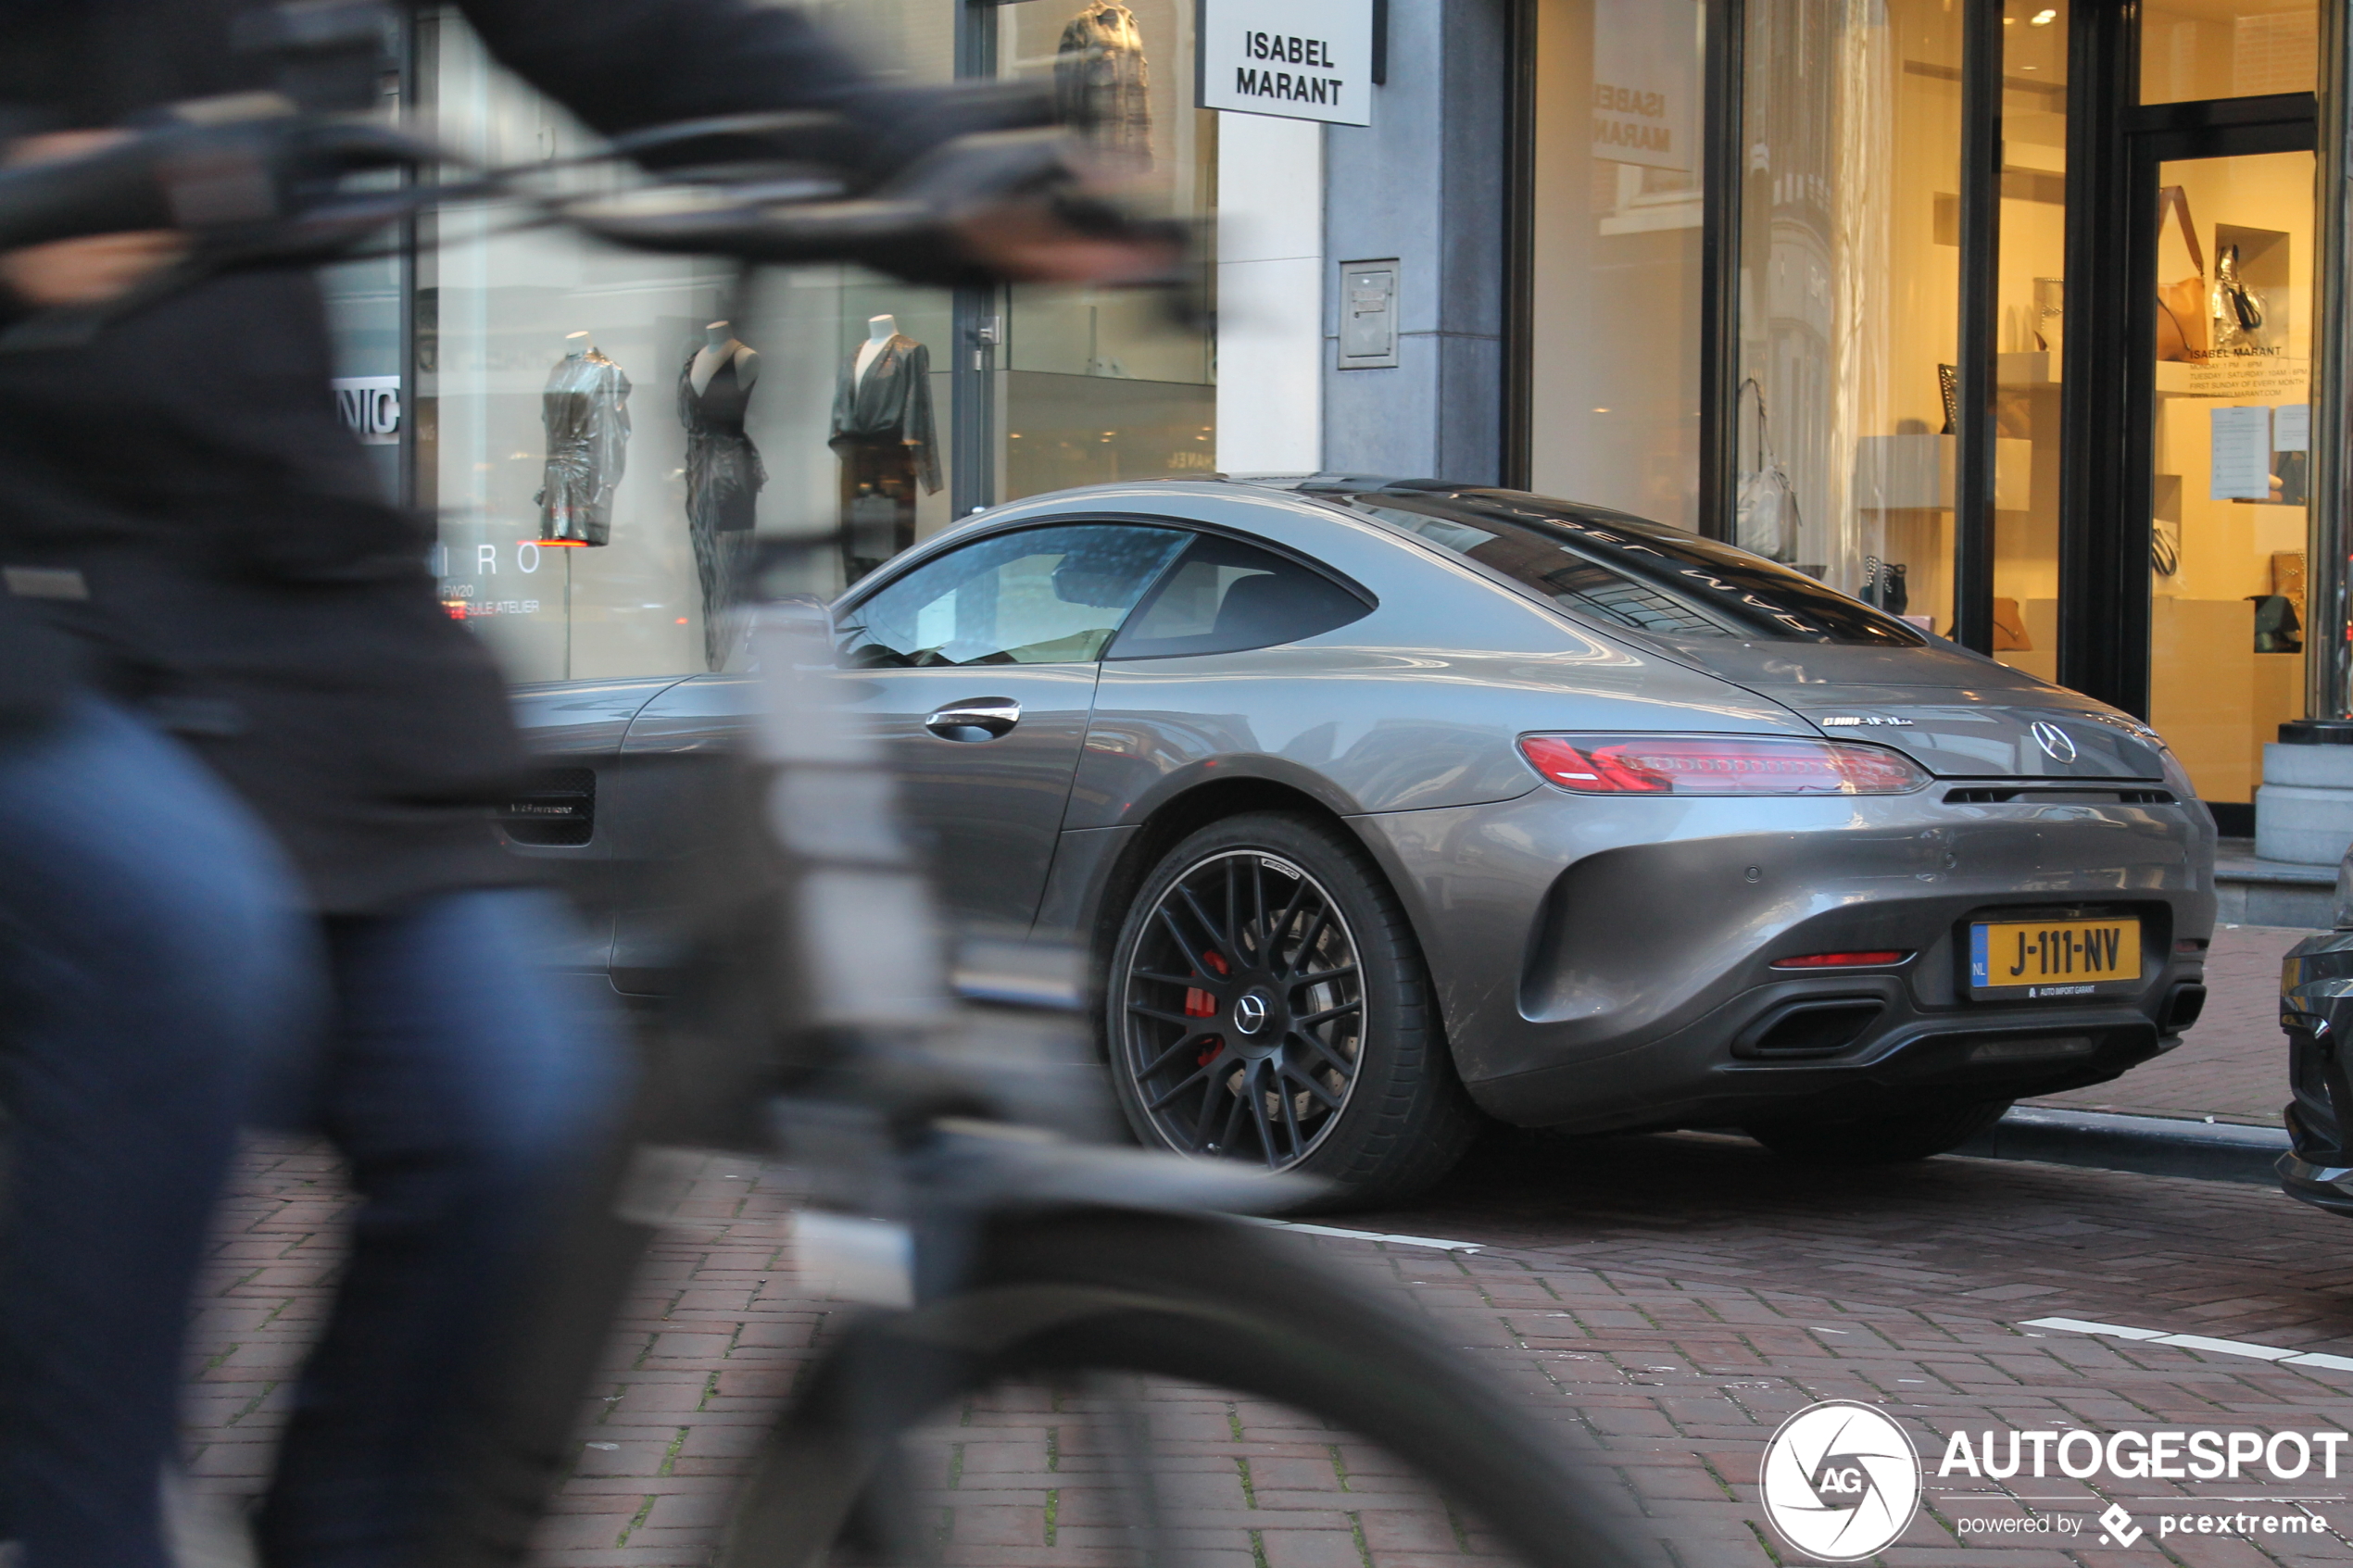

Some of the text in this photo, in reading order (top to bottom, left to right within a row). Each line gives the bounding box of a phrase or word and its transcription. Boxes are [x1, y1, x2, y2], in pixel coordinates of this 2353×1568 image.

[1246, 31, 1335, 68] ISABEL
[1237, 67, 1343, 106] MARANT
[2190, 345, 2282, 359] ISABEL MARANT
[2190, 372, 2221, 381] TUESDAY
[2227, 370, 2264, 379] SATURDAY
[2190, 382, 2209, 390] FIRST
[2211, 381, 2239, 389] SUNDAY
[444, 583, 474, 597] FW20
[495, 599, 540, 613] ATELIER
[2010, 928, 2120, 976] J-111-NV
[1972, 961, 1986, 976] NL
[2040, 985, 2095, 997] AUTO IMPORT GARANT
